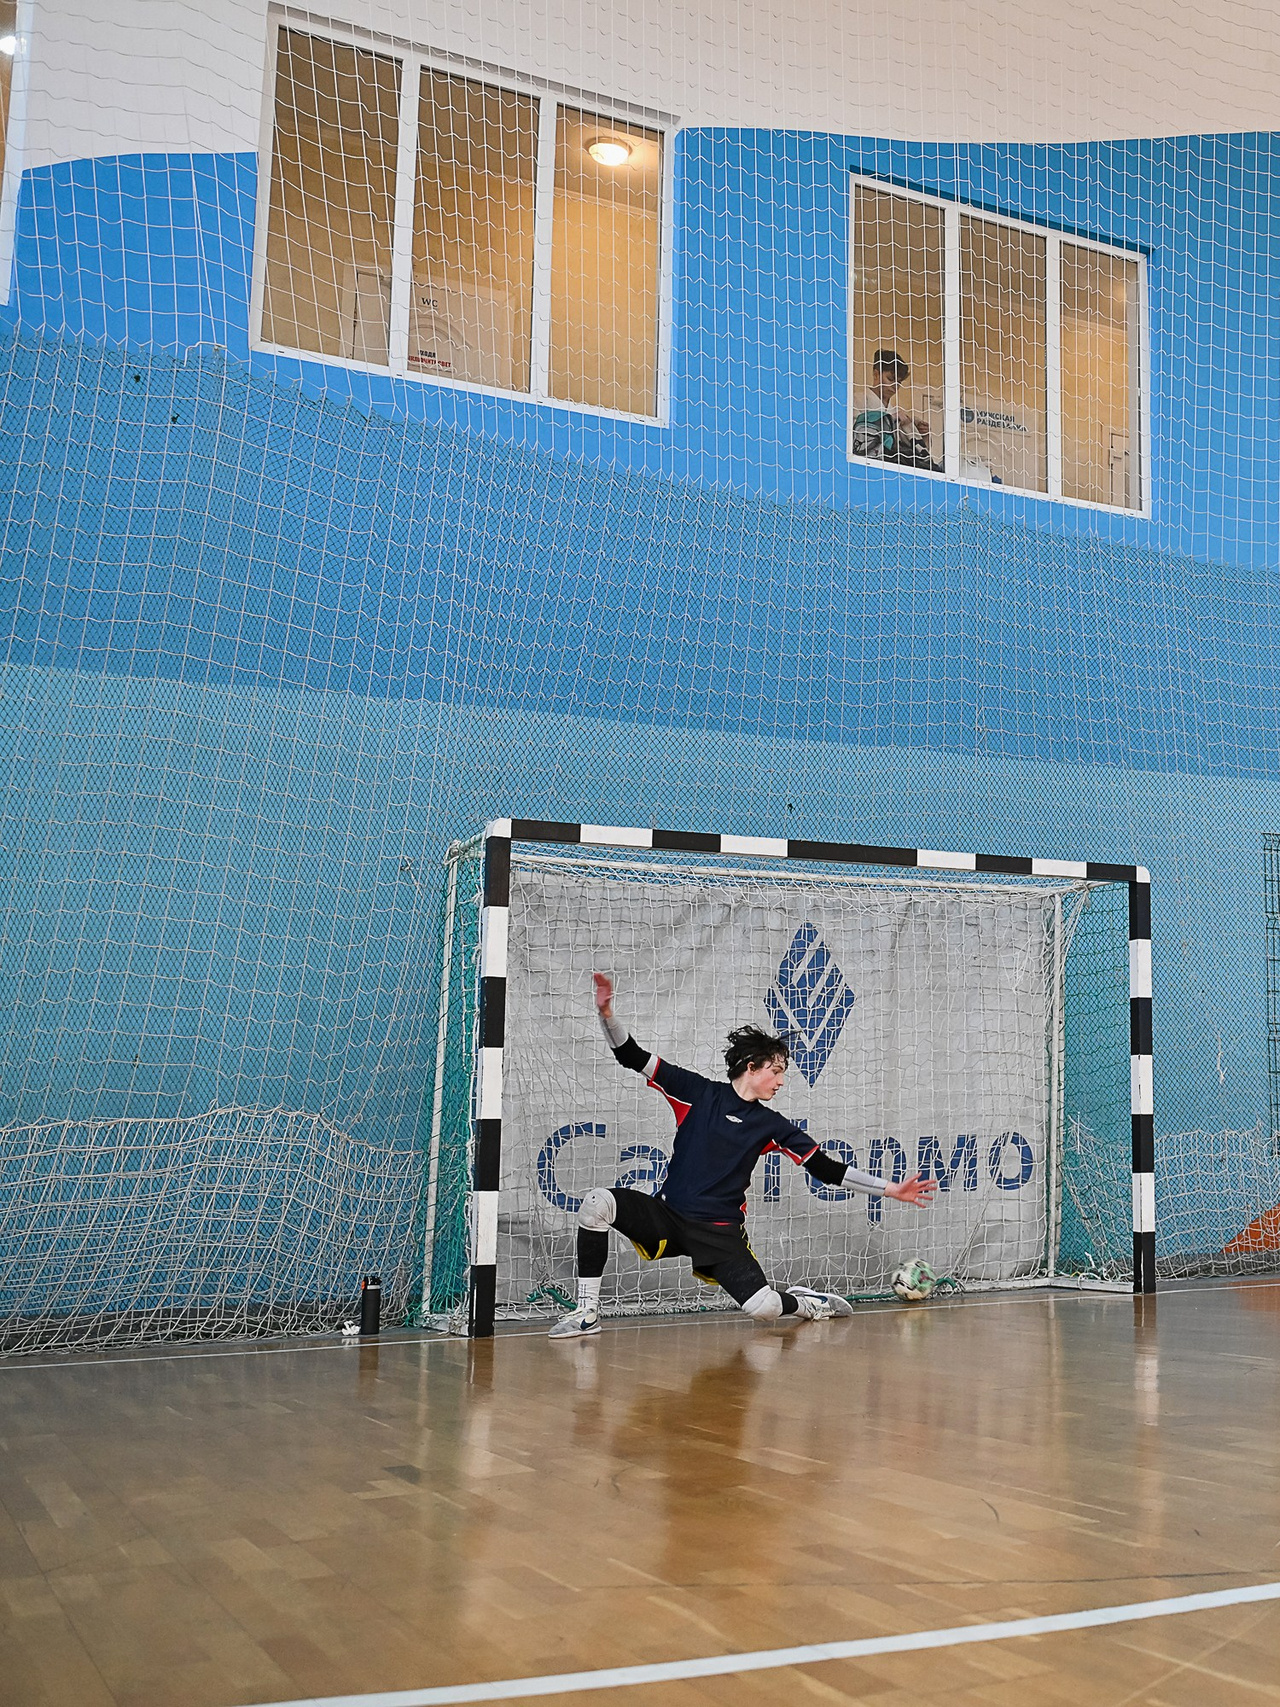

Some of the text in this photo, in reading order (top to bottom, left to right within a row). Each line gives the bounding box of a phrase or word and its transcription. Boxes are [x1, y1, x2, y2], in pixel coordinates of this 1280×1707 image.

[421, 297, 438, 307] WC
[976, 411, 1015, 422] МУЖСКАЯ
[537, 1119, 1034, 1223] СаТермо
